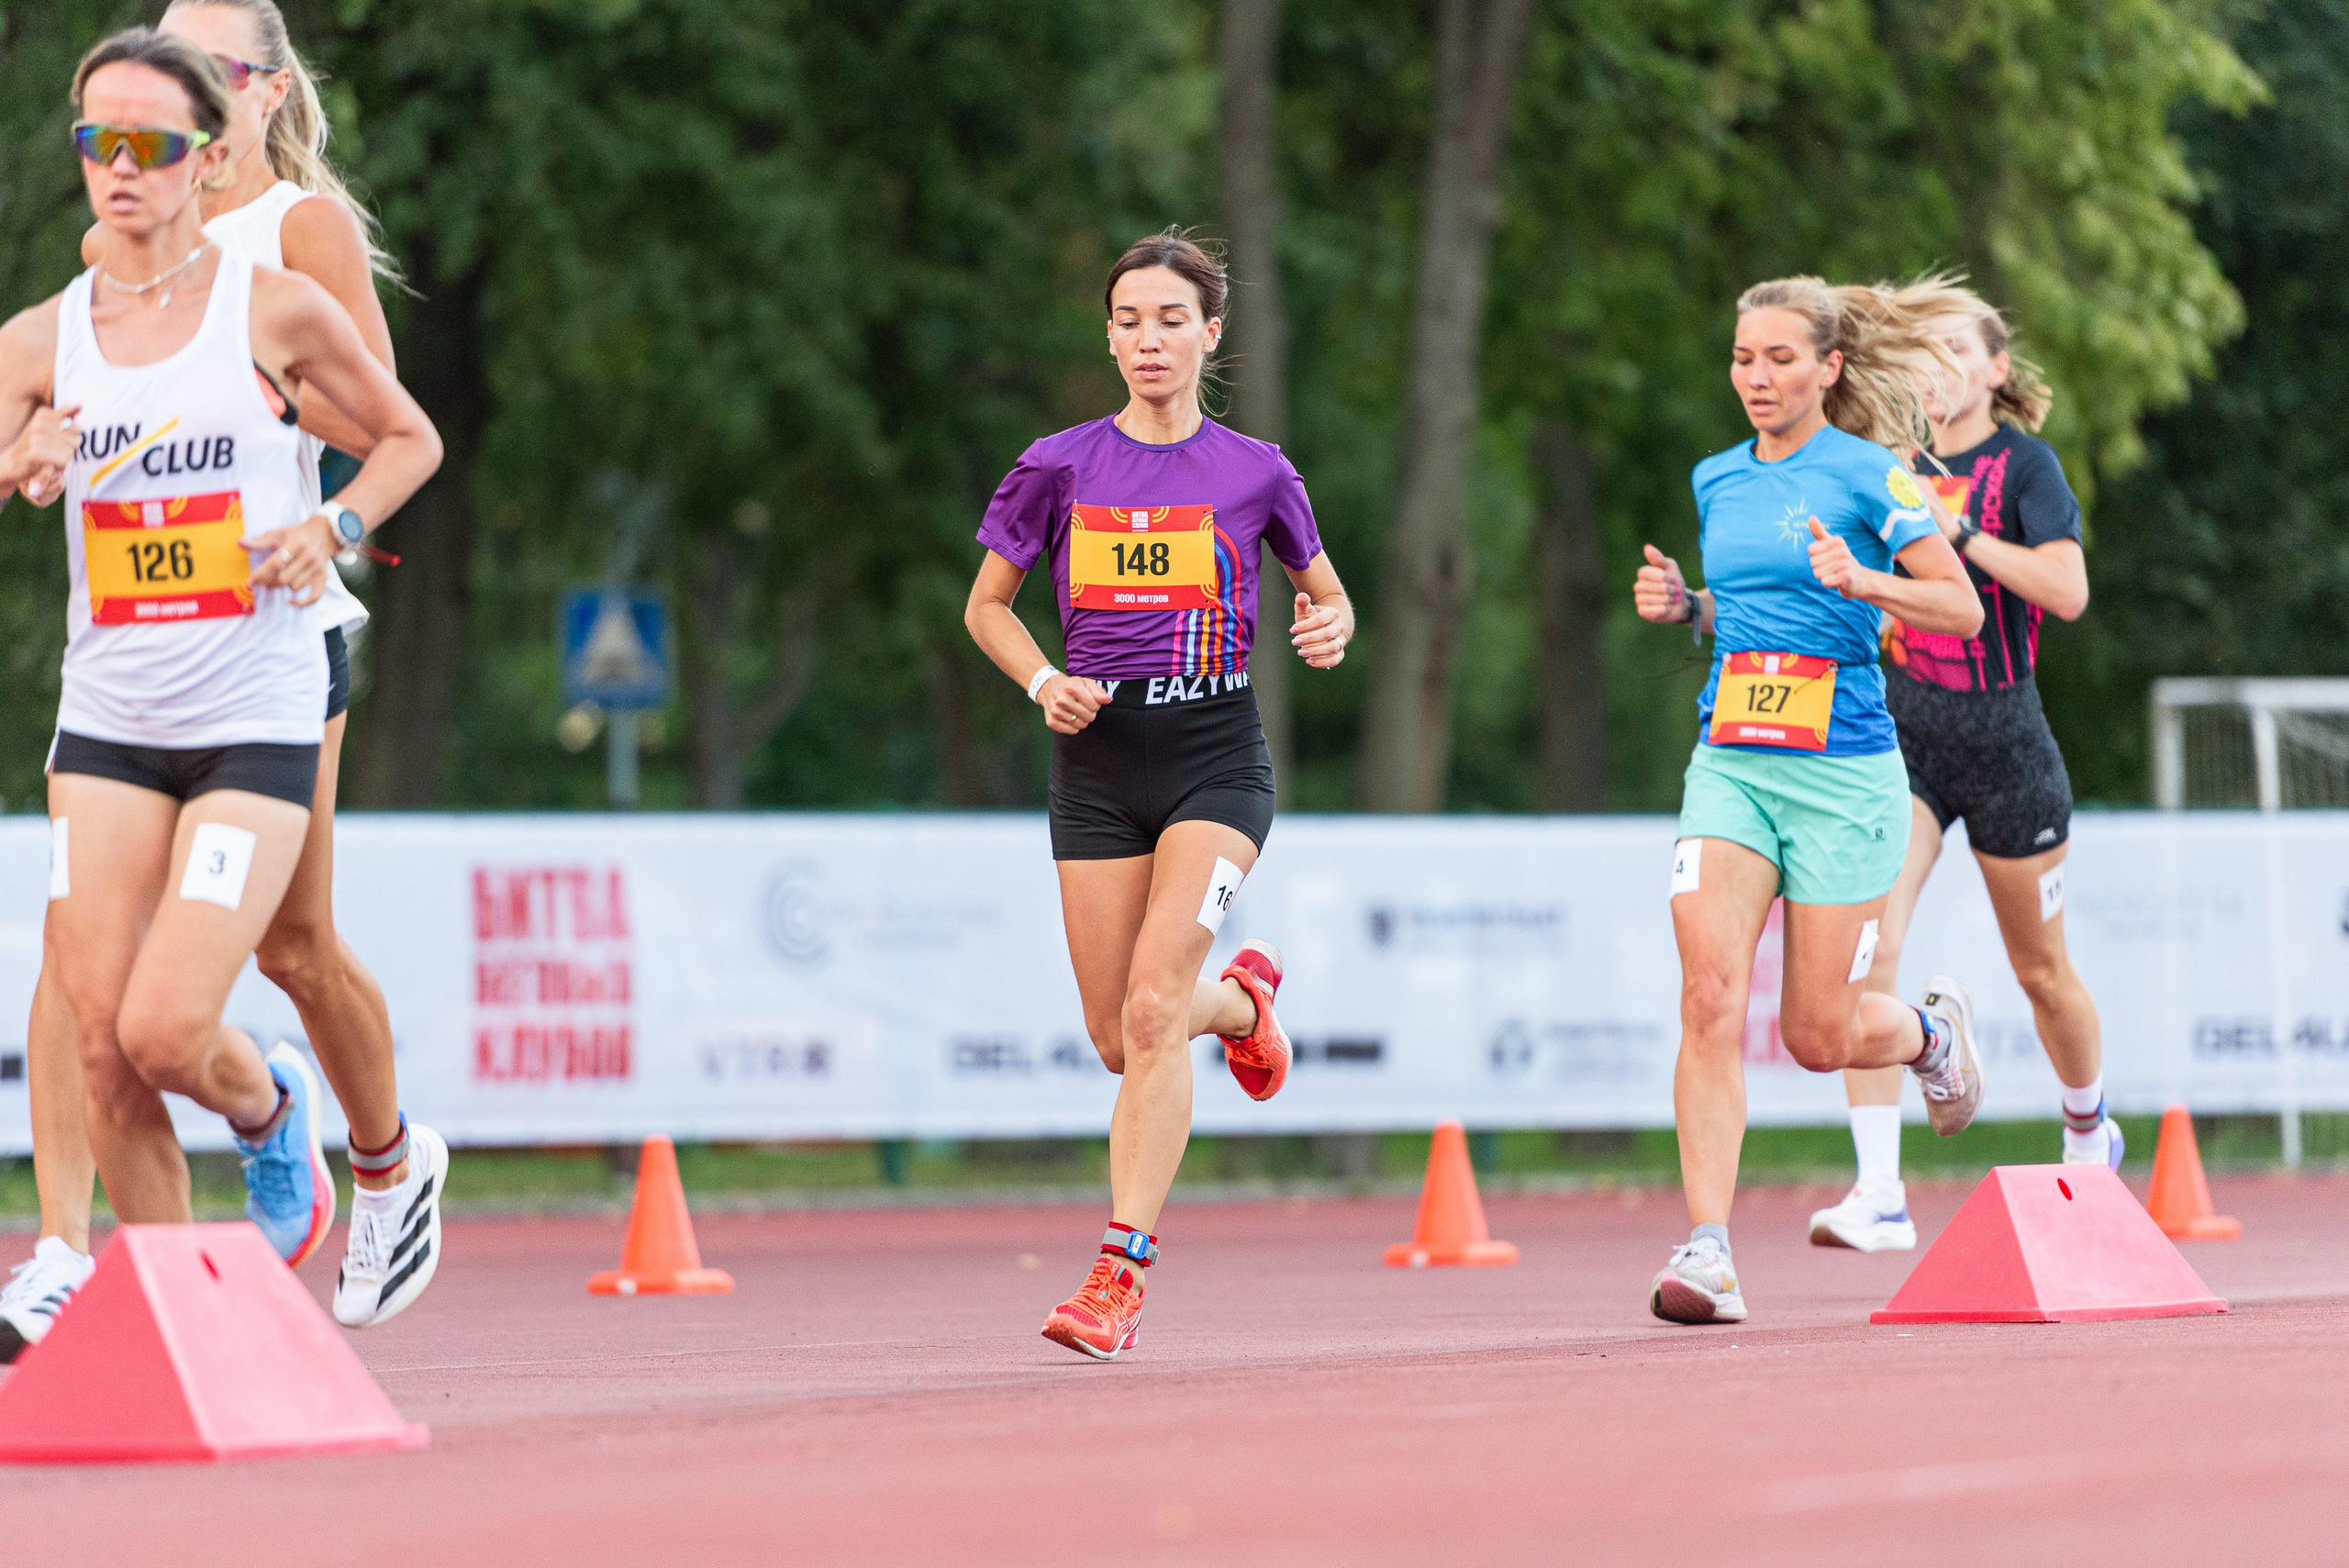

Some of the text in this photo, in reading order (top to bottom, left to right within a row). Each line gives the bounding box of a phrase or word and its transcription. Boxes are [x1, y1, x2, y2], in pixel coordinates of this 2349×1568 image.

[74, 422, 140, 462] RUN
[141, 435, 235, 477] CLUB
[127, 539, 195, 582] 126
[1111, 542, 1170, 576] 148
[1114, 593, 1170, 605] 3000 метров
[1747, 684, 1791, 713] 127
[208, 850, 226, 874] 3
[1675, 859, 1685, 874] 4
[1217, 884, 1233, 912] 16
